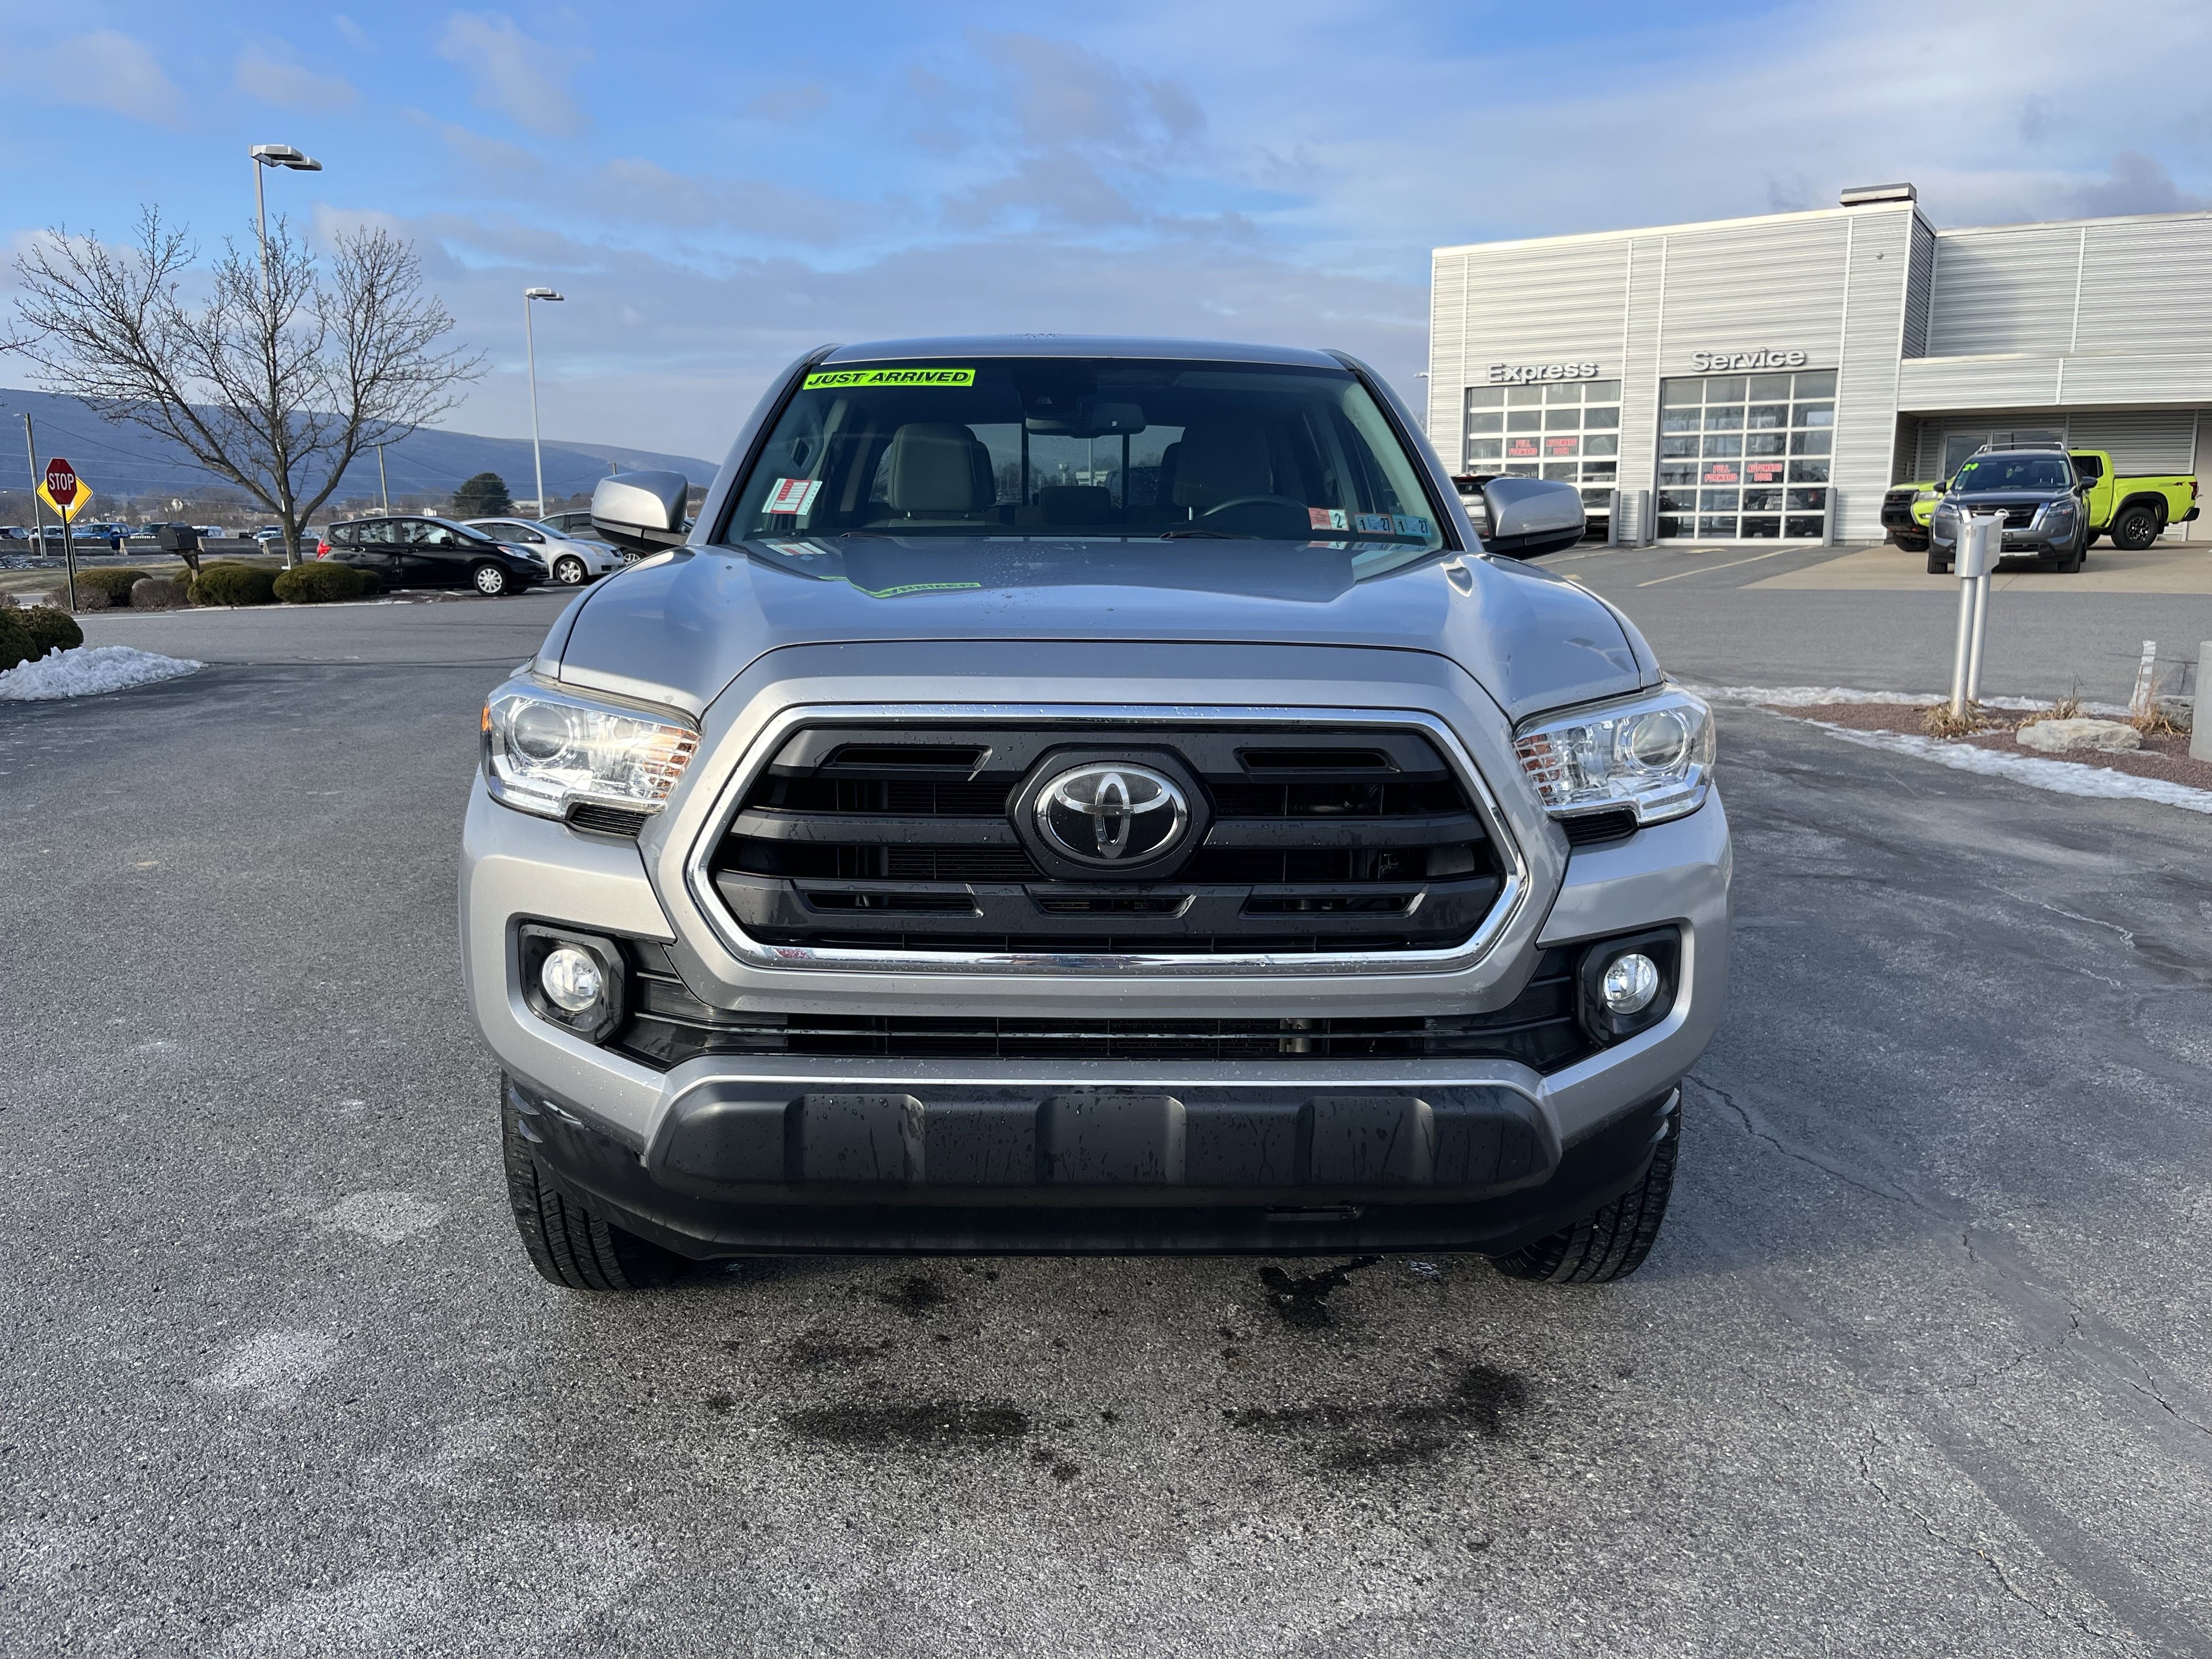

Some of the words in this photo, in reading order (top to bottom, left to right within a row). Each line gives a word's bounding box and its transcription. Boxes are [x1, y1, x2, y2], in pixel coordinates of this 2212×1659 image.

[1690, 347, 1806, 371] Service
[807, 373, 868, 386] JUST
[867, 371, 972, 383] ARRIVED
[1486, 362, 1597, 385] Express
[1515, 439, 1531, 448] PULL
[1508, 448, 1537, 456] FORWARD
[1713, 464, 1730, 473] PULL
[1747, 463, 1782, 473] AUTOMATIC
[48, 473, 74, 490] STOP
[1704, 473, 1737, 482] FORWARD
[1334, 513, 1342, 528] 2
[1359, 519, 1366, 531] 1
[1380, 517, 1390, 532] 27
[1398, 521, 1405, 533] 1
[1418, 519, 1428, 534] 27
